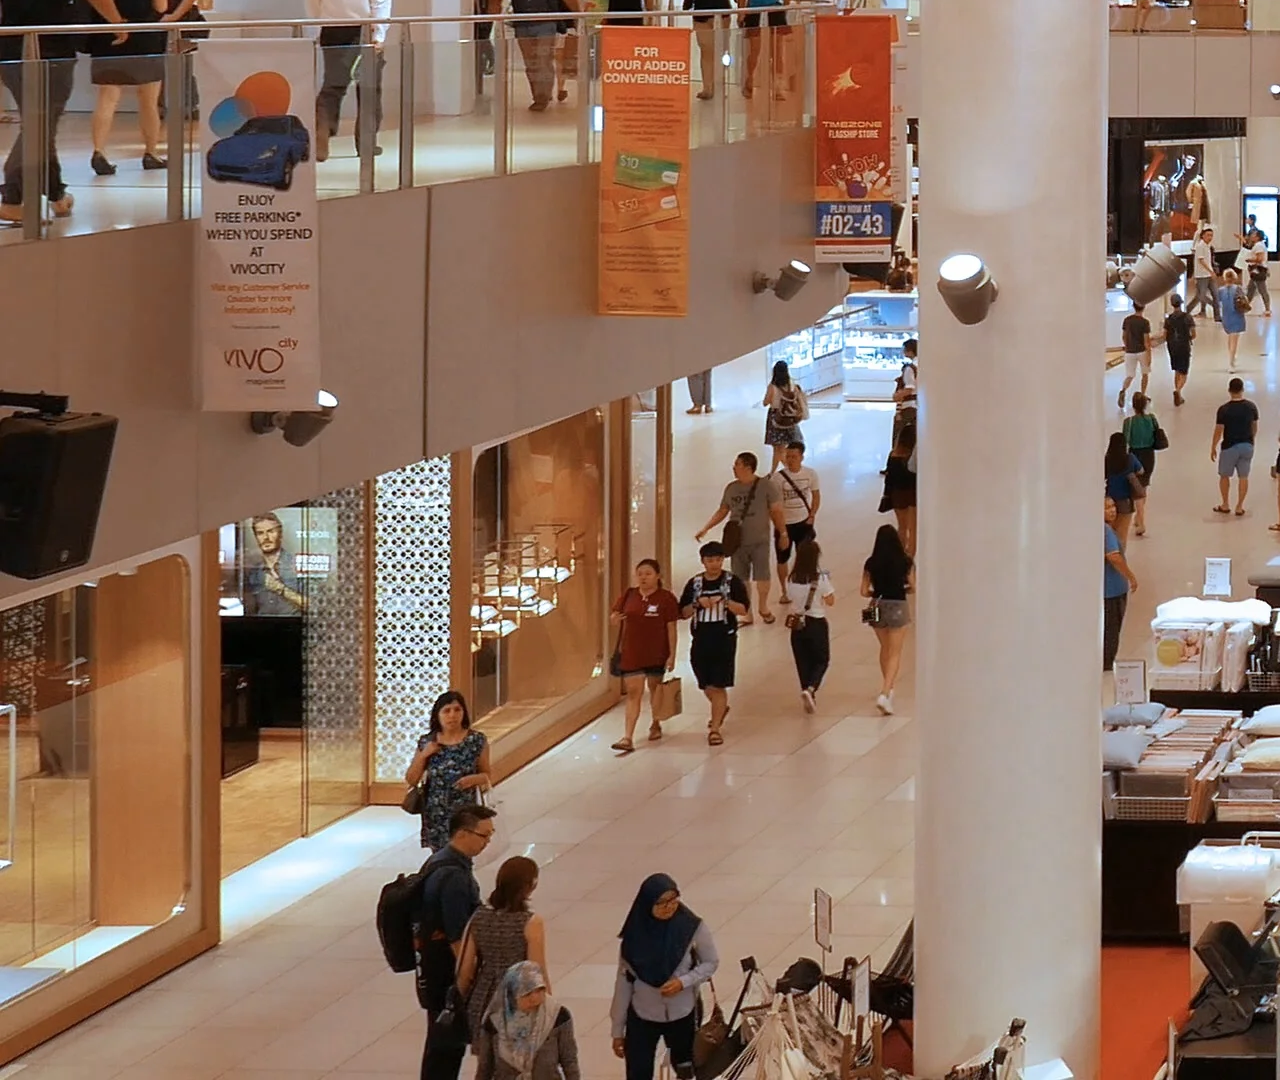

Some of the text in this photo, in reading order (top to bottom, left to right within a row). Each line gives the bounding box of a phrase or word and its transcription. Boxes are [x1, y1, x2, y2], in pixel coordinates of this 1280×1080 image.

[634, 46, 659, 57] FOR
[606, 59, 686, 72] YOUR ADDED
[603, 72, 690, 85] CONVENIENCE
[828, 129, 879, 139] FLAGSHIP STORE
[238, 195, 276, 207] ENJOY
[830, 204, 872, 214] PLAY NOW AT
[215, 212, 242, 224] FREE
[821, 214, 884, 236] #02-43
[206, 228, 313, 240] WHEN YOU SPEND
[249, 246, 265, 257] AT
[230, 263, 286, 275] VIVOCITY
[223, 347, 284, 374] VIVO
